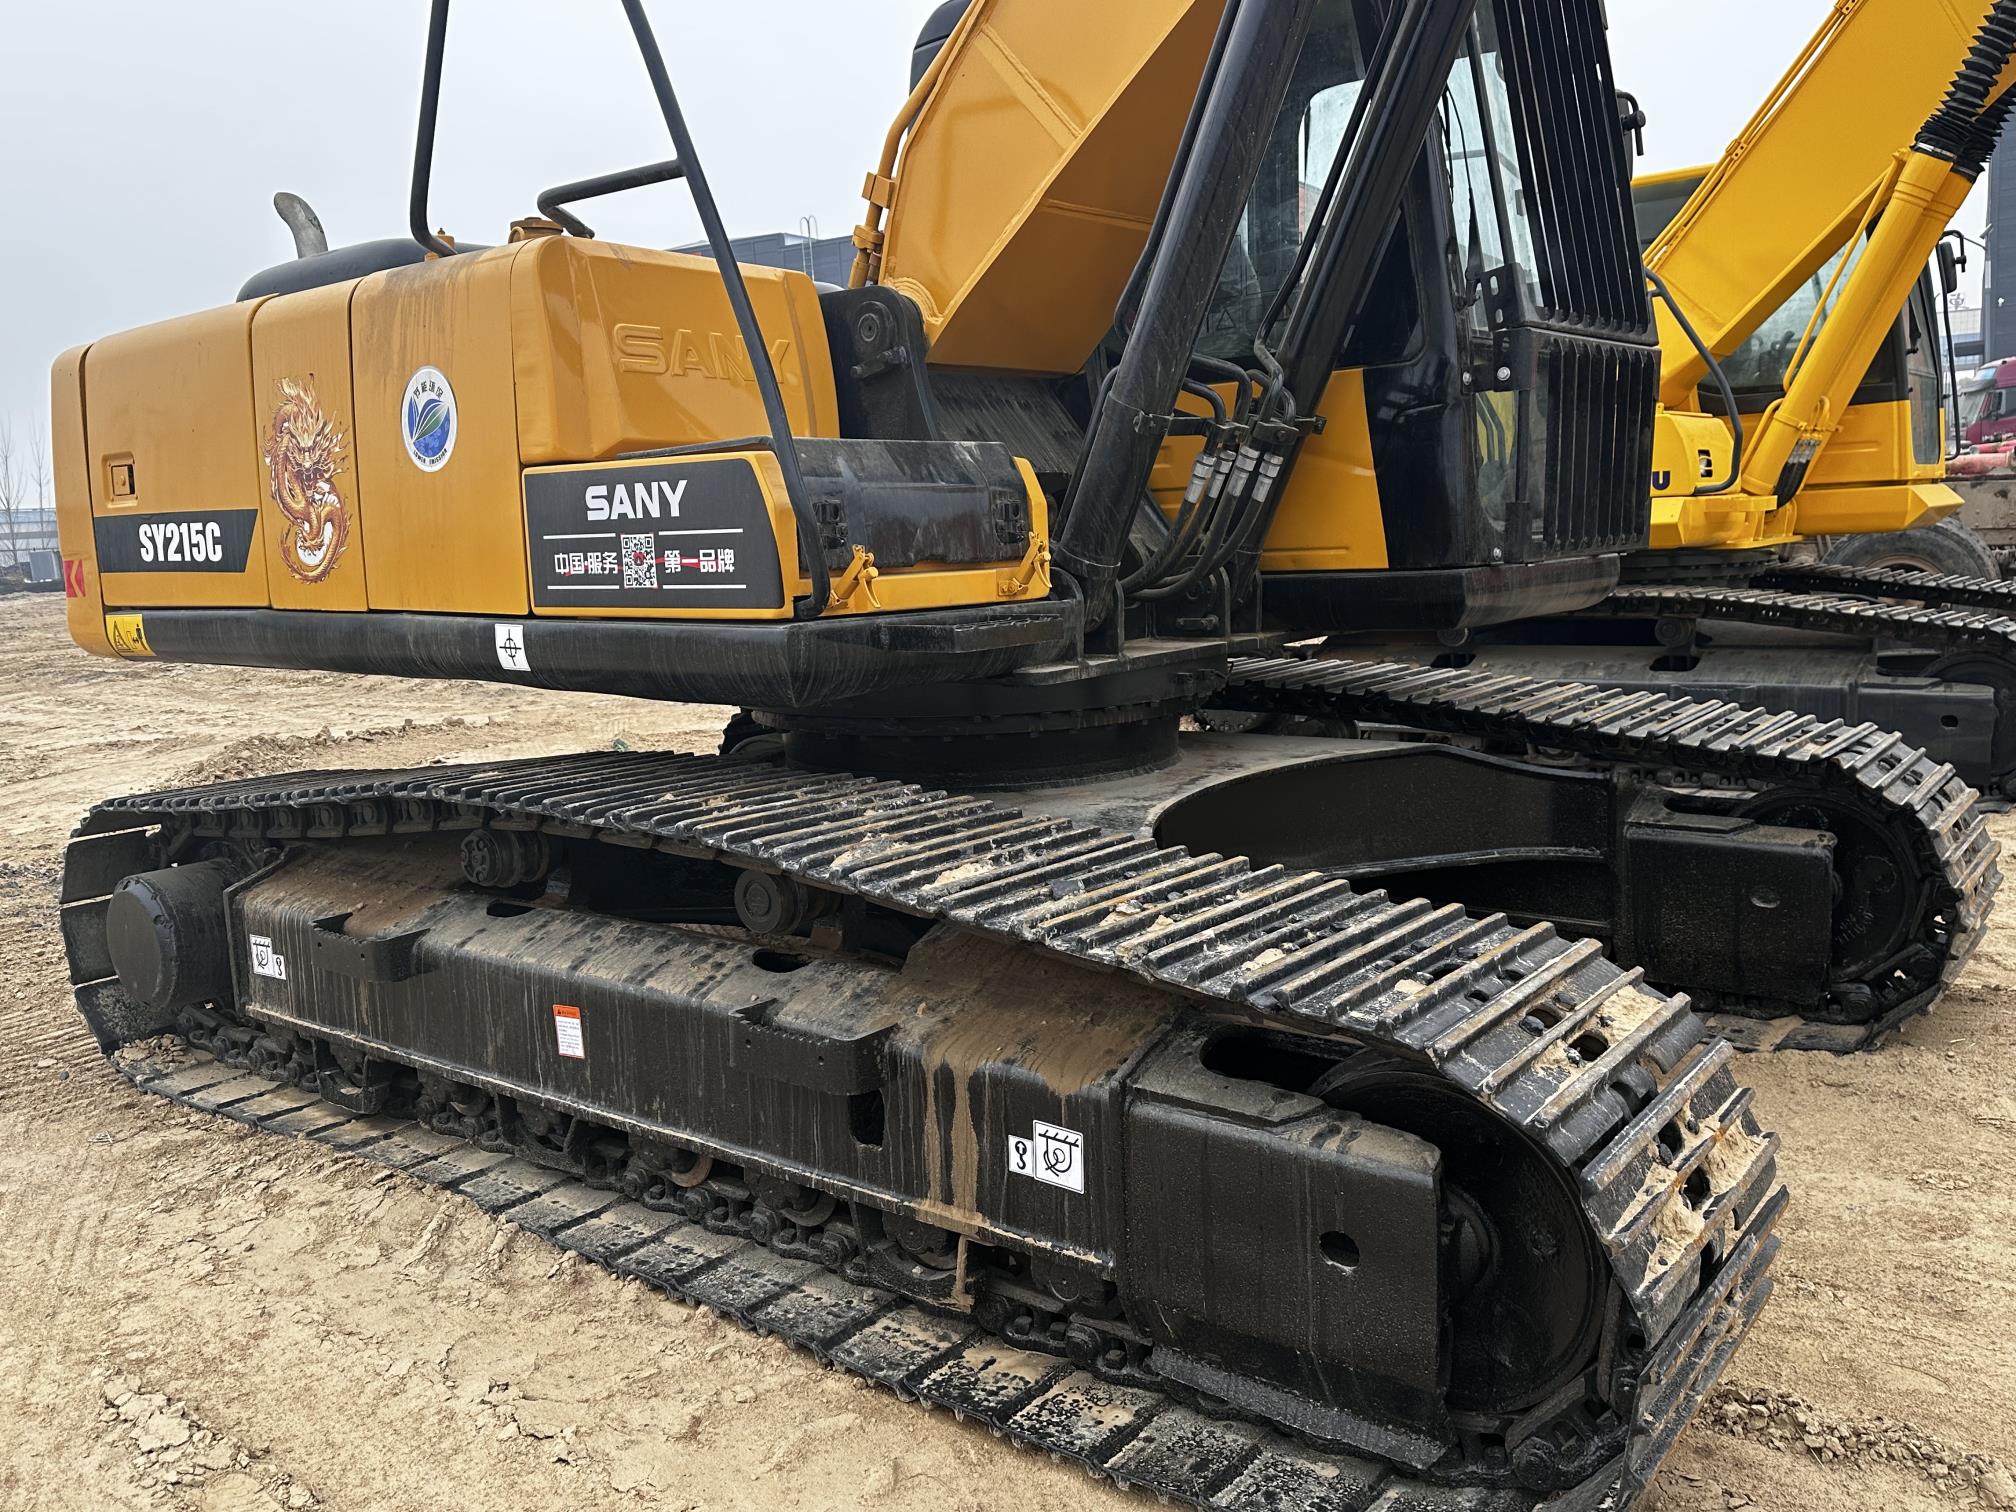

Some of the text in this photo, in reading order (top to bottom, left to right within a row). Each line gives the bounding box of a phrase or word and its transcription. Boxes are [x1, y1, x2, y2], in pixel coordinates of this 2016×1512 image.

[614, 323, 791, 384] SANY
[585, 480, 688, 521] SANY
[139, 521, 223, 563] SY215C
[664, 548, 735, 574] 第一品牌
